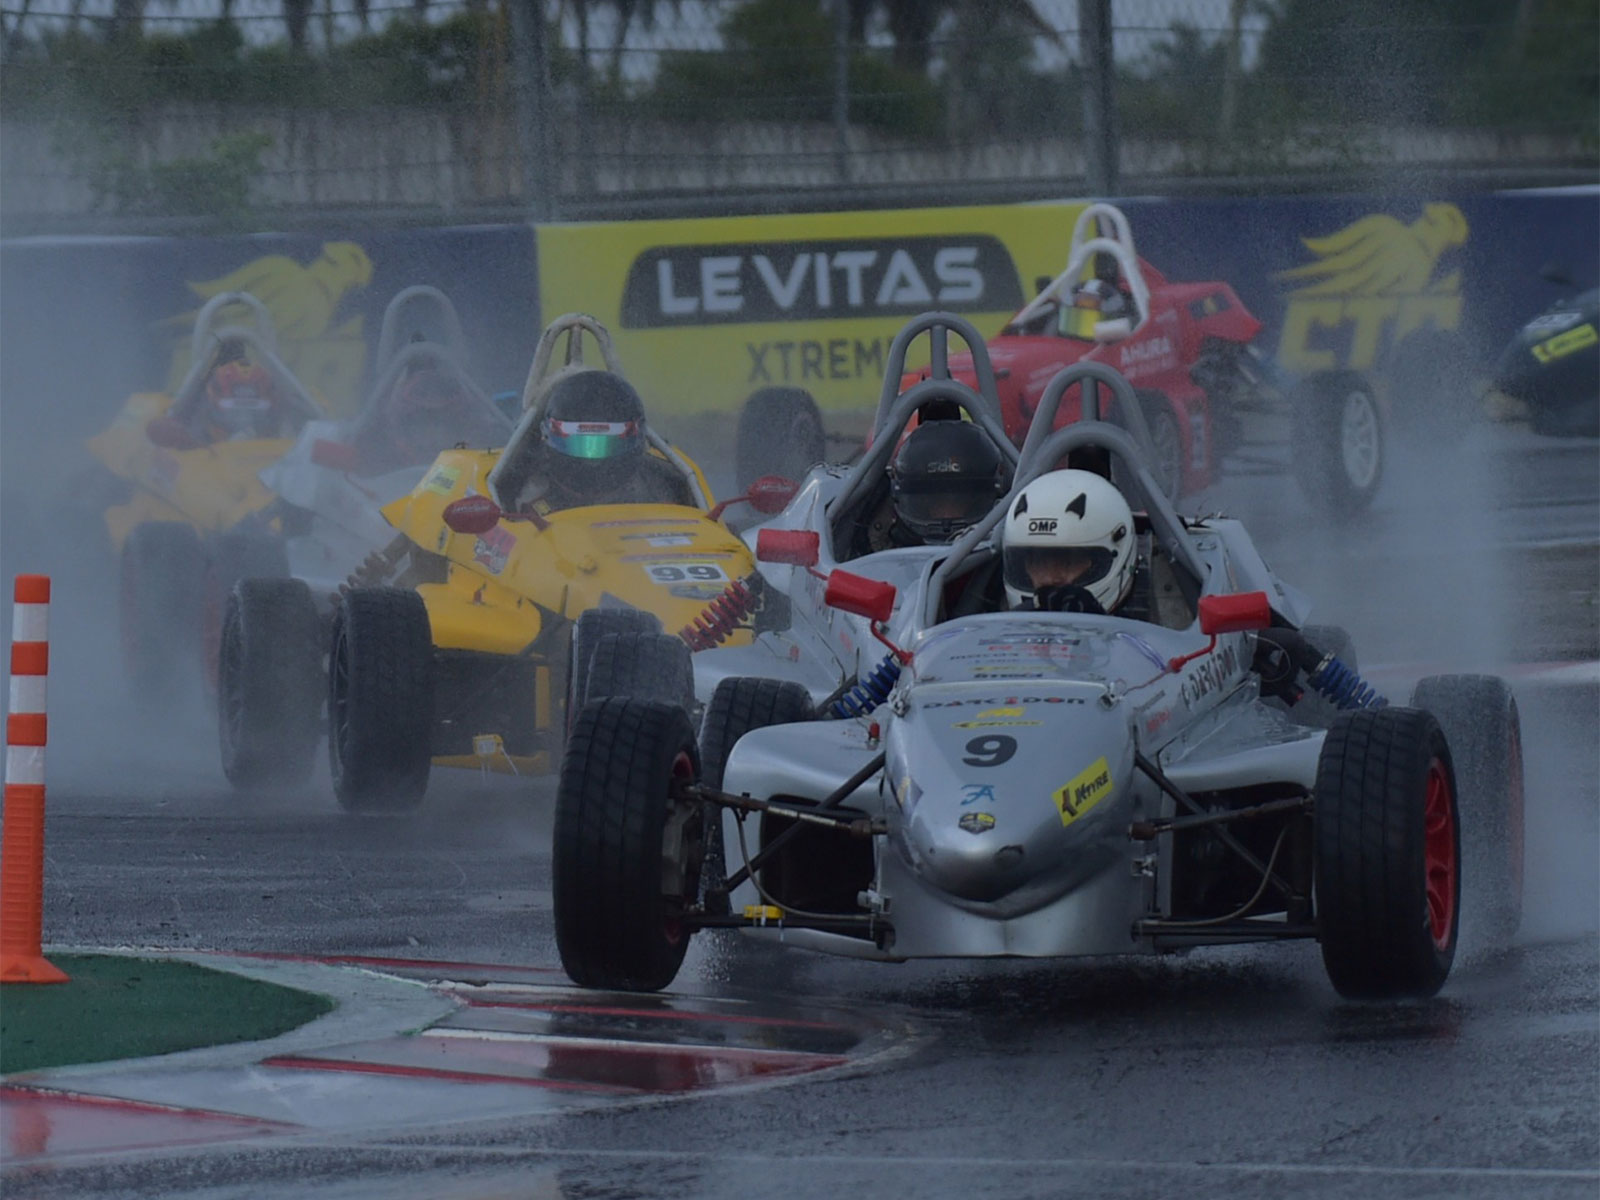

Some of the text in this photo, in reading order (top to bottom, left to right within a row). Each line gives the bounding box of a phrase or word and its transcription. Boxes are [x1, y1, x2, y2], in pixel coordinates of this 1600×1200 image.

[657, 246, 985, 315] LEVITAS
[1028, 521, 1058, 533] OMP
[651, 565, 722, 582] 99
[961, 734, 1018, 768] 9
